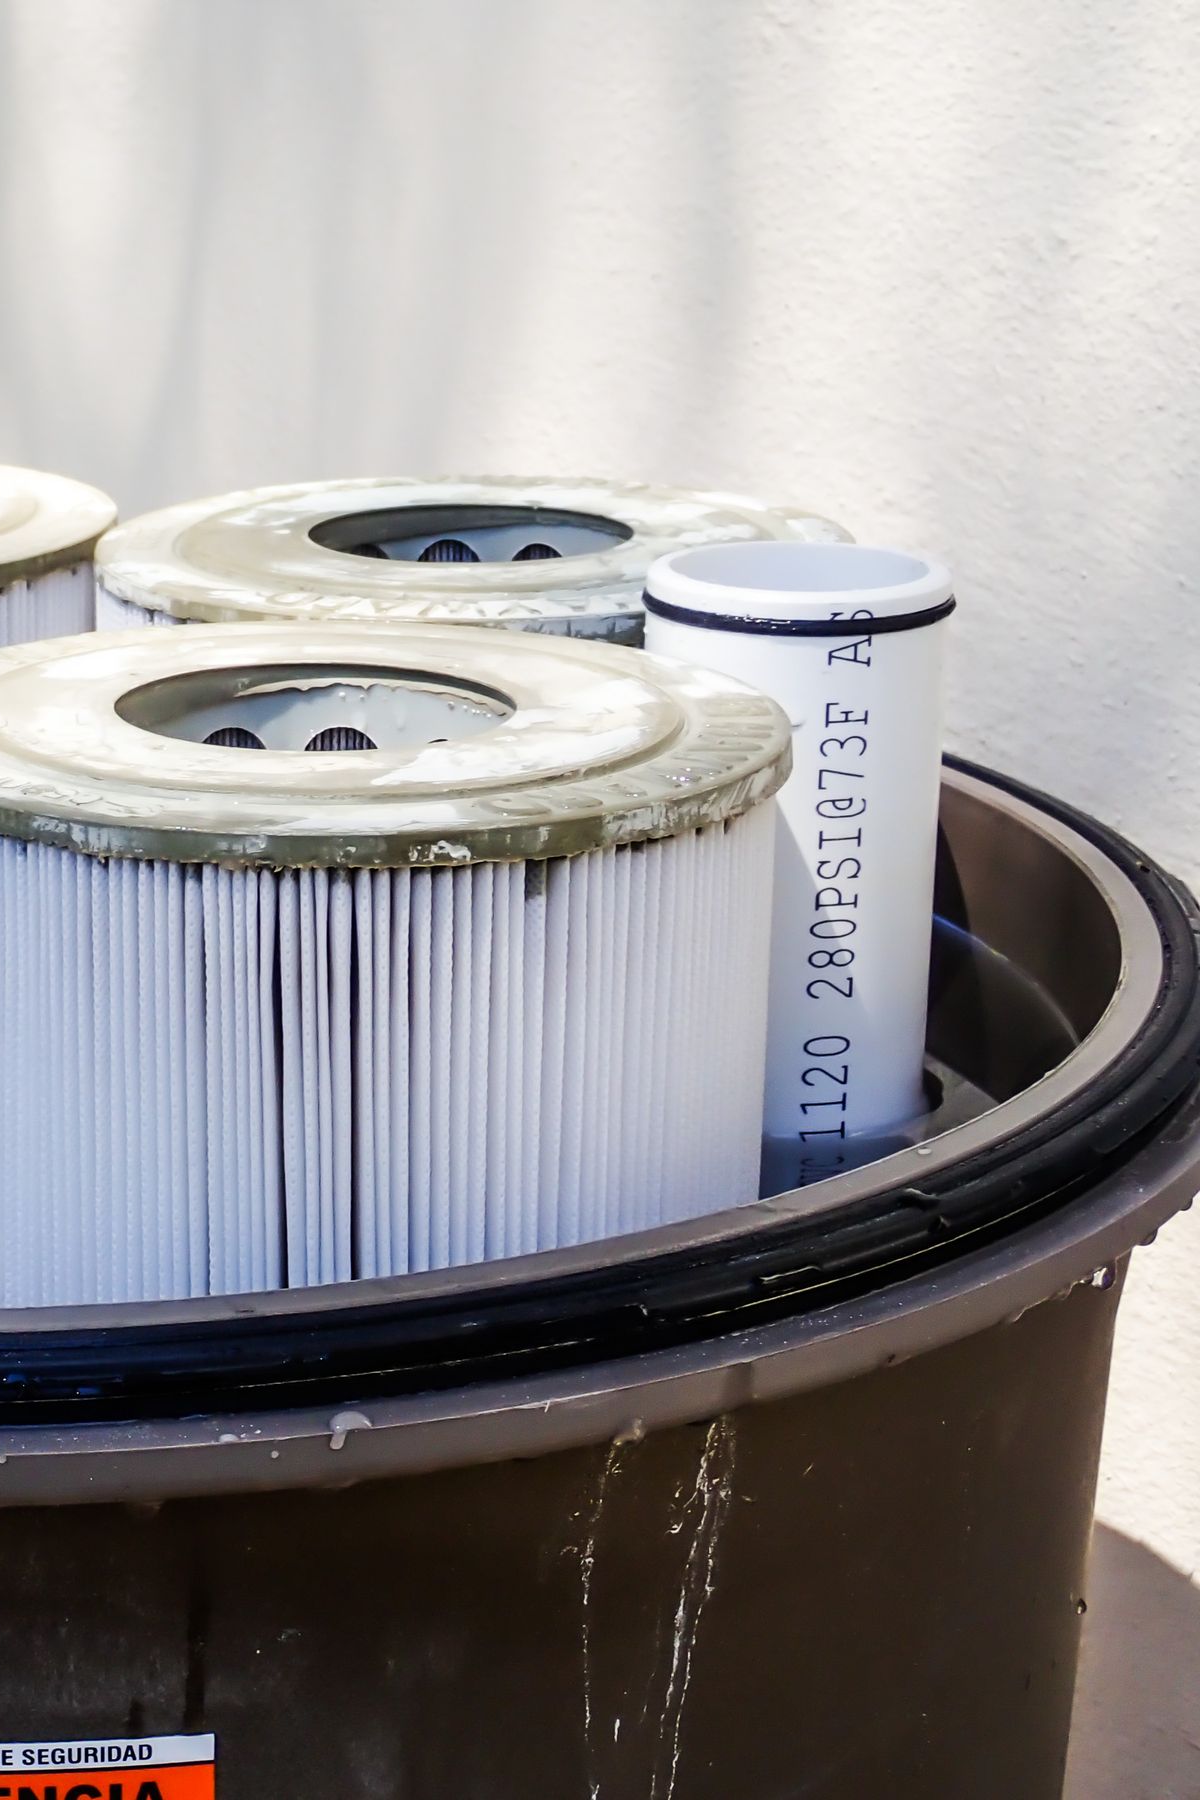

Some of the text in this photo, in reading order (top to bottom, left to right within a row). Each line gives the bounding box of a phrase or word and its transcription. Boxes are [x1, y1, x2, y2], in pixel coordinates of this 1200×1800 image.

[807, 702, 869, 1000] 280PSI@73F
[799, 1034, 852, 1143] 1120
[22, 1743, 153, 1766] SEGURIDAD
